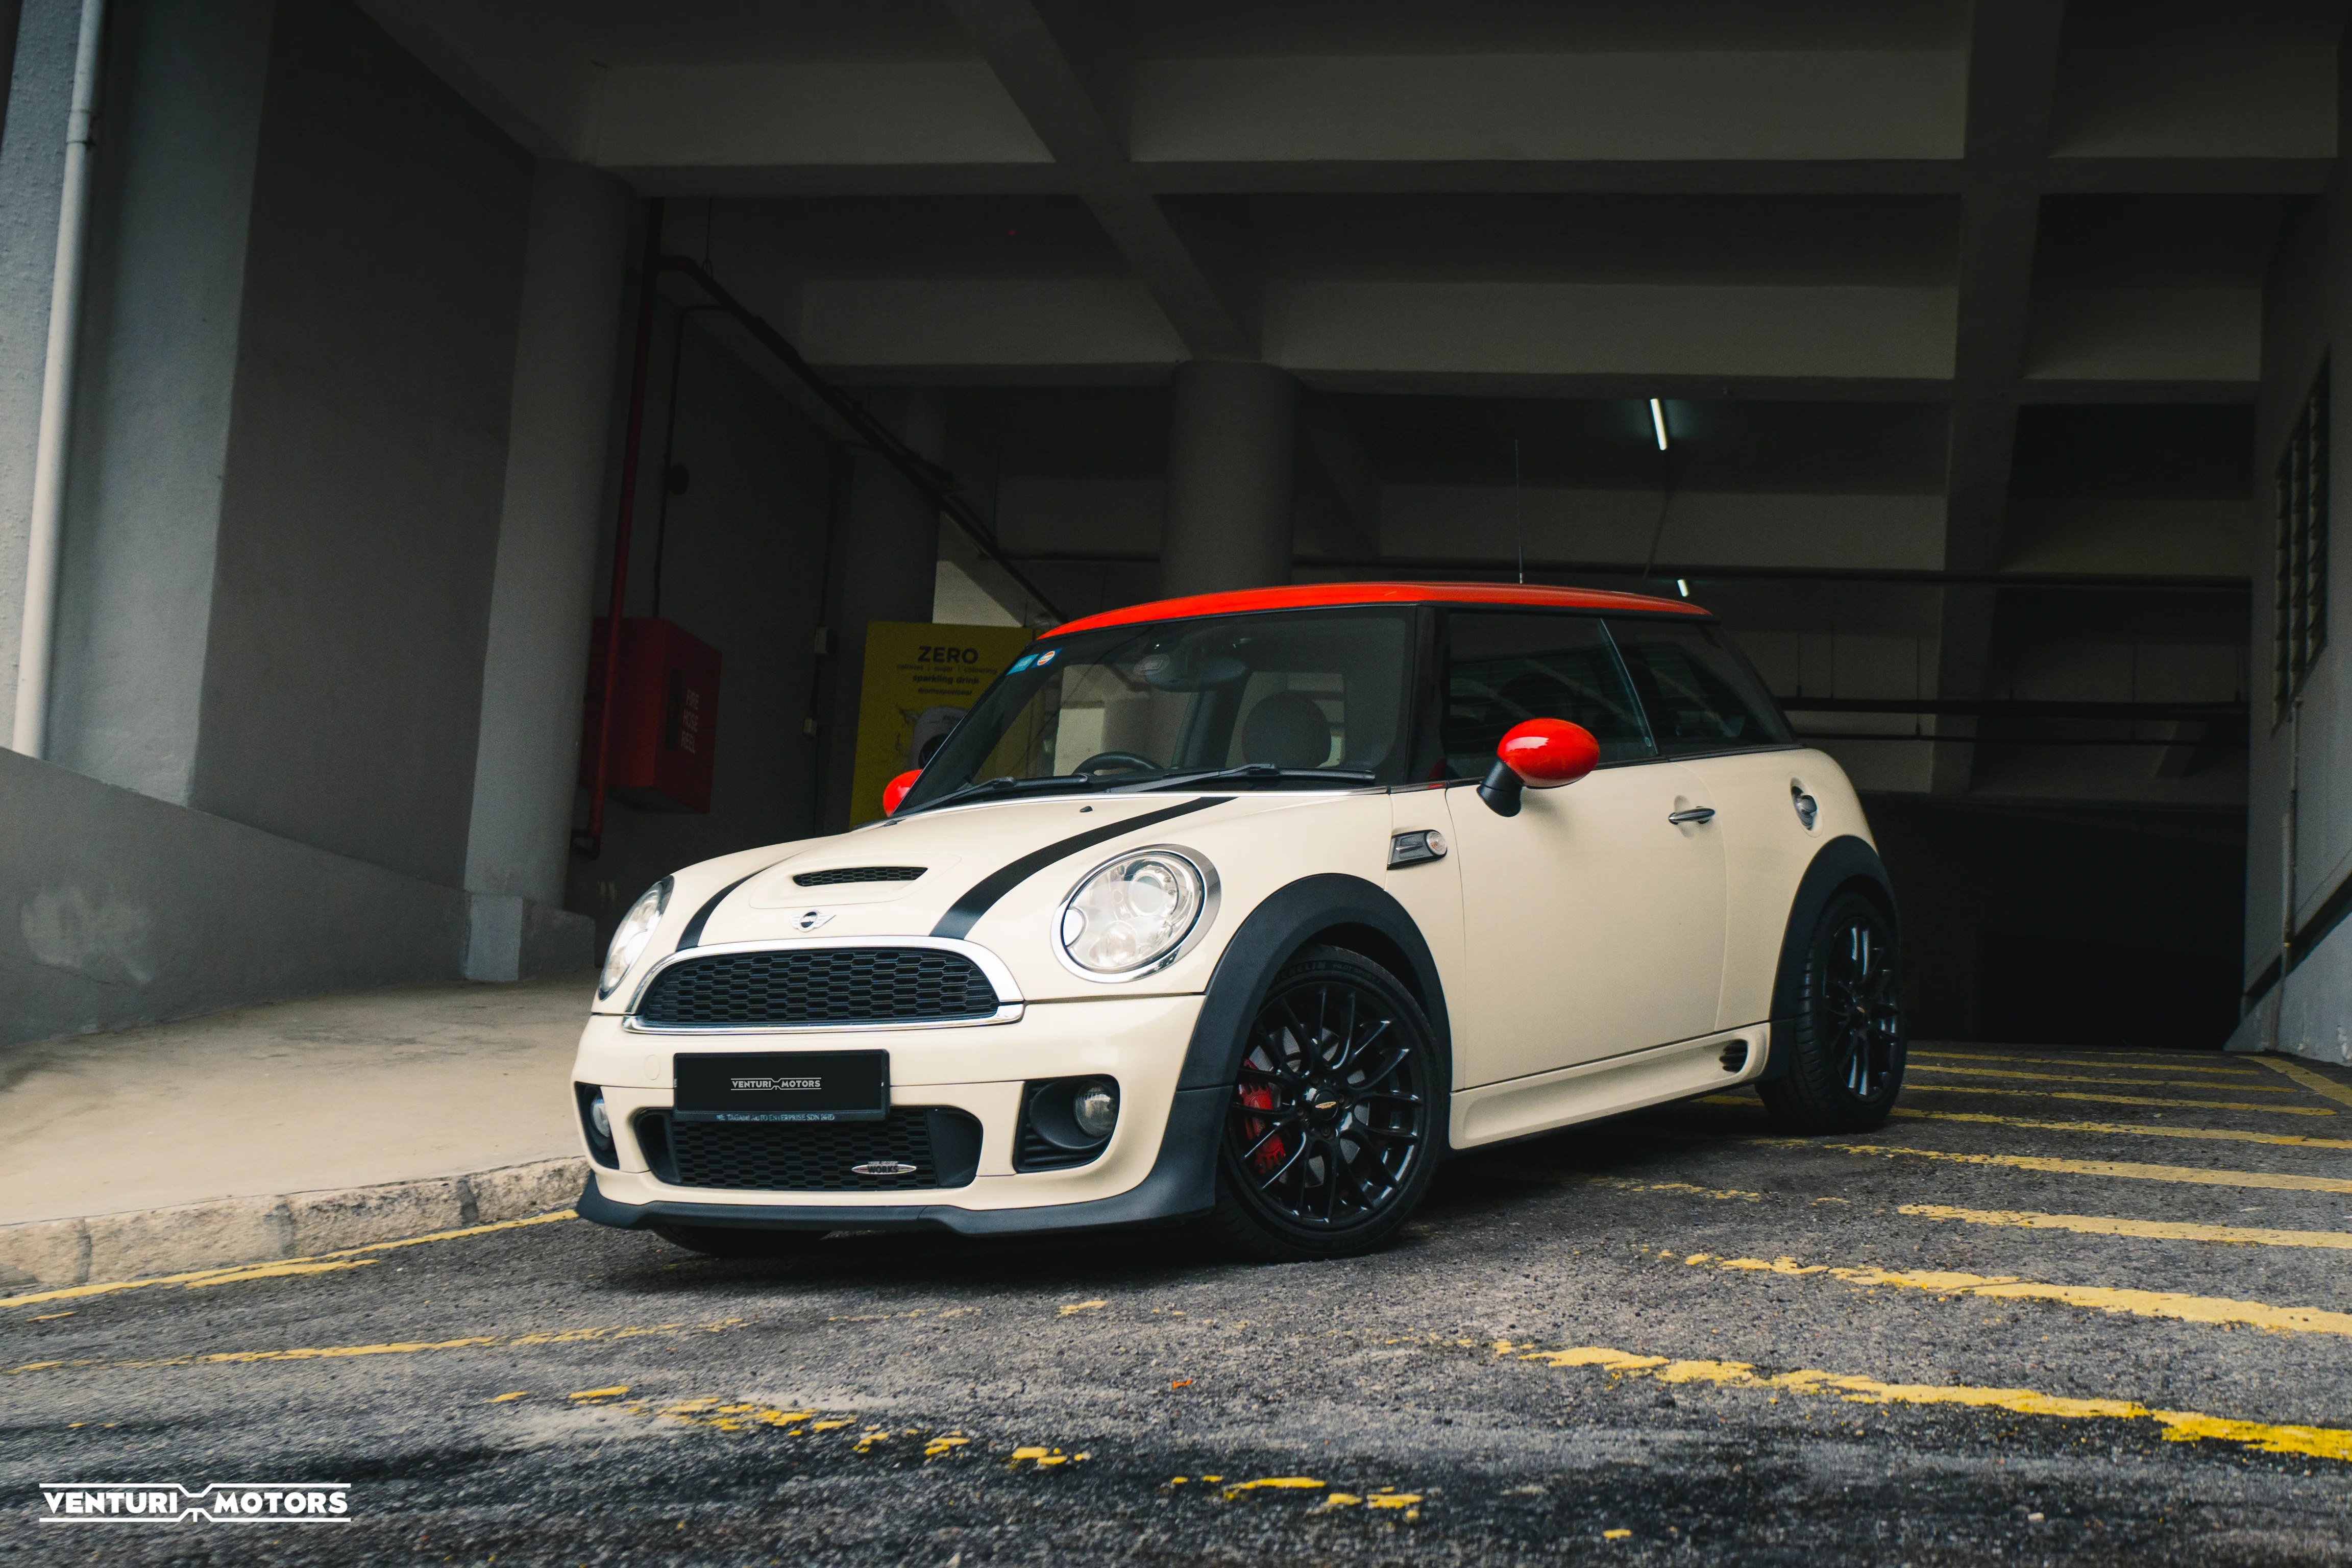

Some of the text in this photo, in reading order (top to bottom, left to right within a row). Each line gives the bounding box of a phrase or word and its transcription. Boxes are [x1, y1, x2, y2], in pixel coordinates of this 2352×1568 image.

[918, 646, 978, 664] ZERO
[913, 675, 979, 684] sparkling drink
[686, 689, 699, 710] FIRE
[683, 708, 699, 732] HOSE
[681, 730, 696, 754] REEL
[1333, 963, 1353, 971] PILOT
